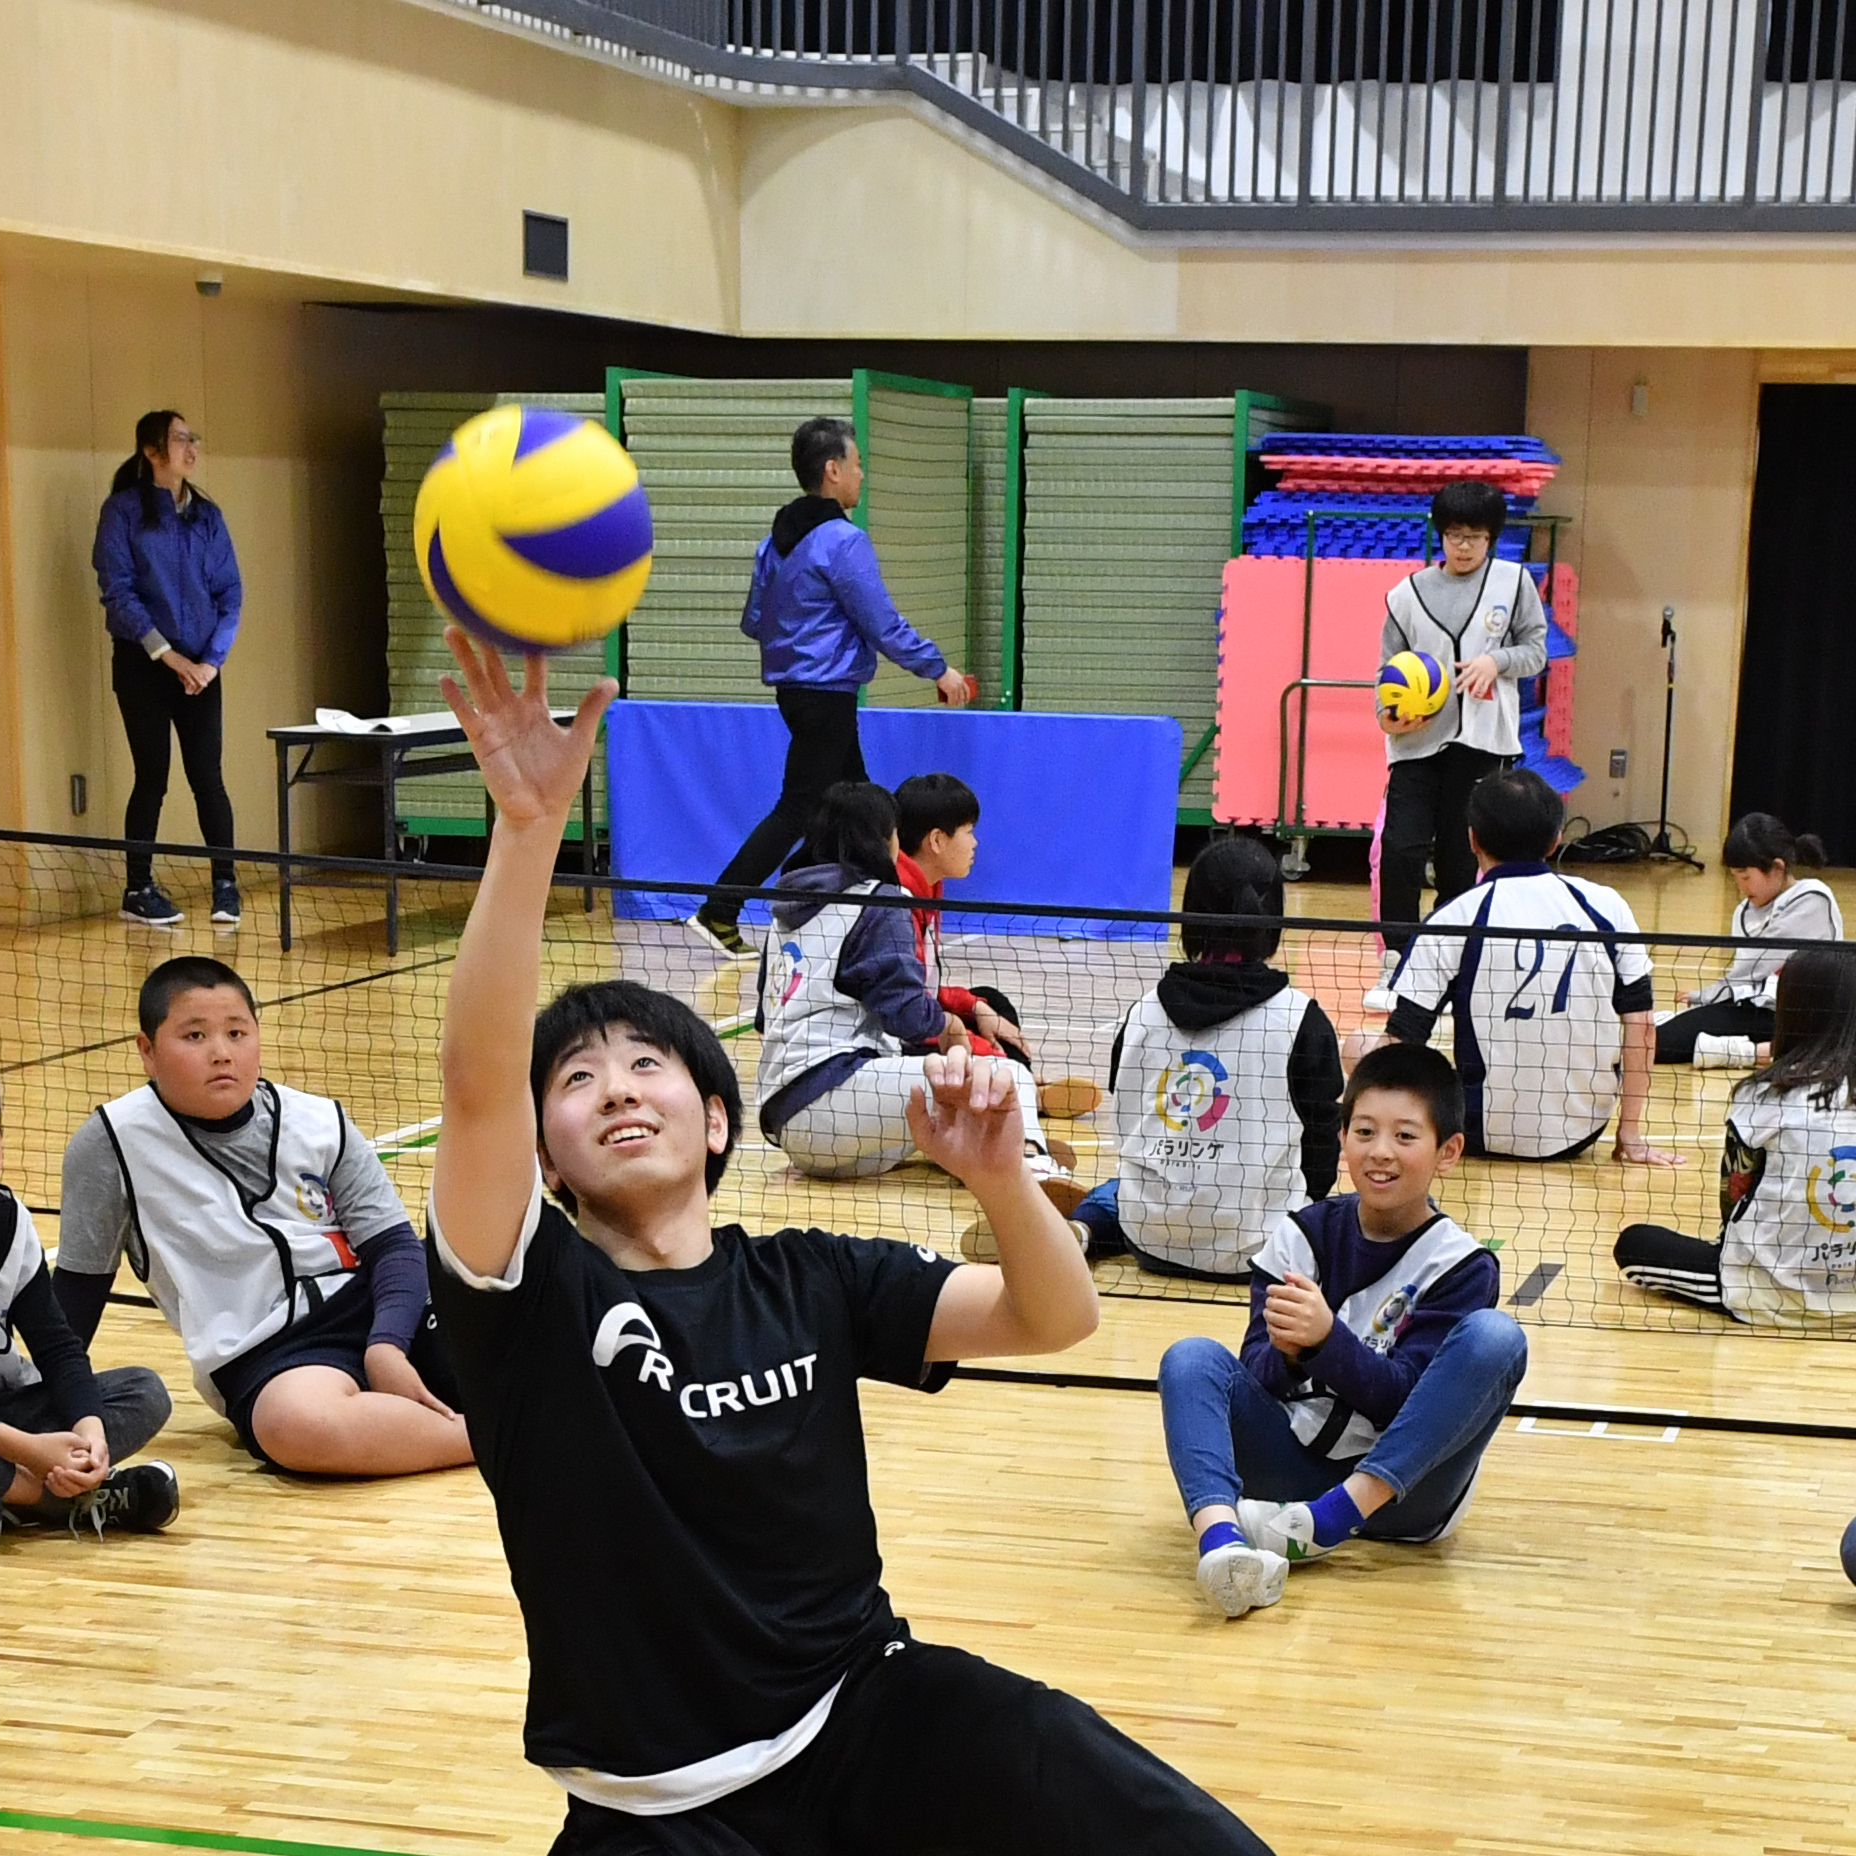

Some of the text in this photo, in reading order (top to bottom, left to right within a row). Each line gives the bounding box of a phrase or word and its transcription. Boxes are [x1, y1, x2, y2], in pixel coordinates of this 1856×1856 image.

[1148, 1139, 1224, 1160] パラリング
